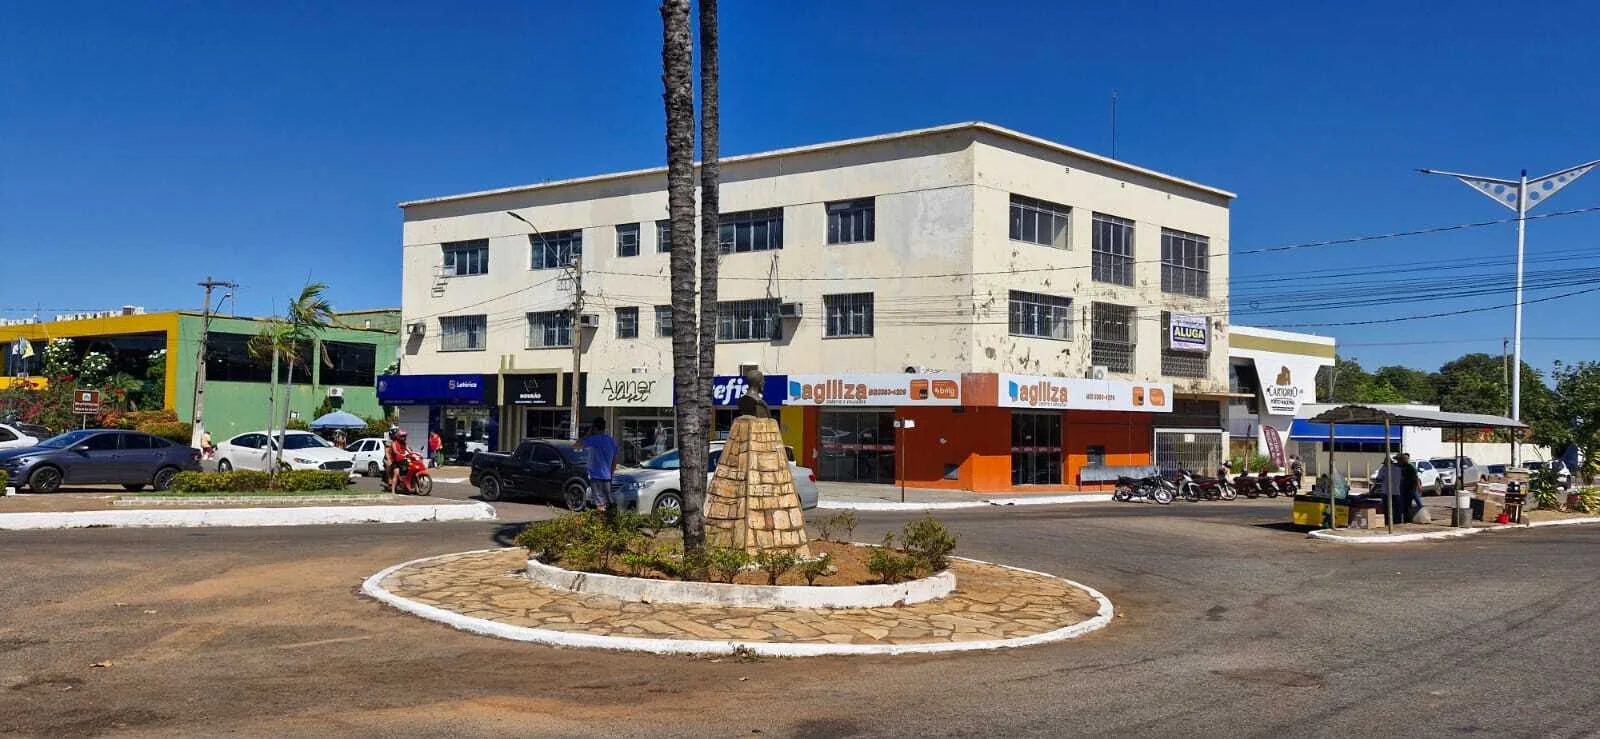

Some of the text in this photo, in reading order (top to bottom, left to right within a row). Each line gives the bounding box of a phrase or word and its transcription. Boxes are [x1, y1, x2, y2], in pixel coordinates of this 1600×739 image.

[1174, 326, 1205, 339] ALUGA
[601, 378, 657, 394] Anner
[713, 378, 749, 405] efis
[802, 379, 868, 404] agiliza
[1019, 381, 1068, 406] agiliza
